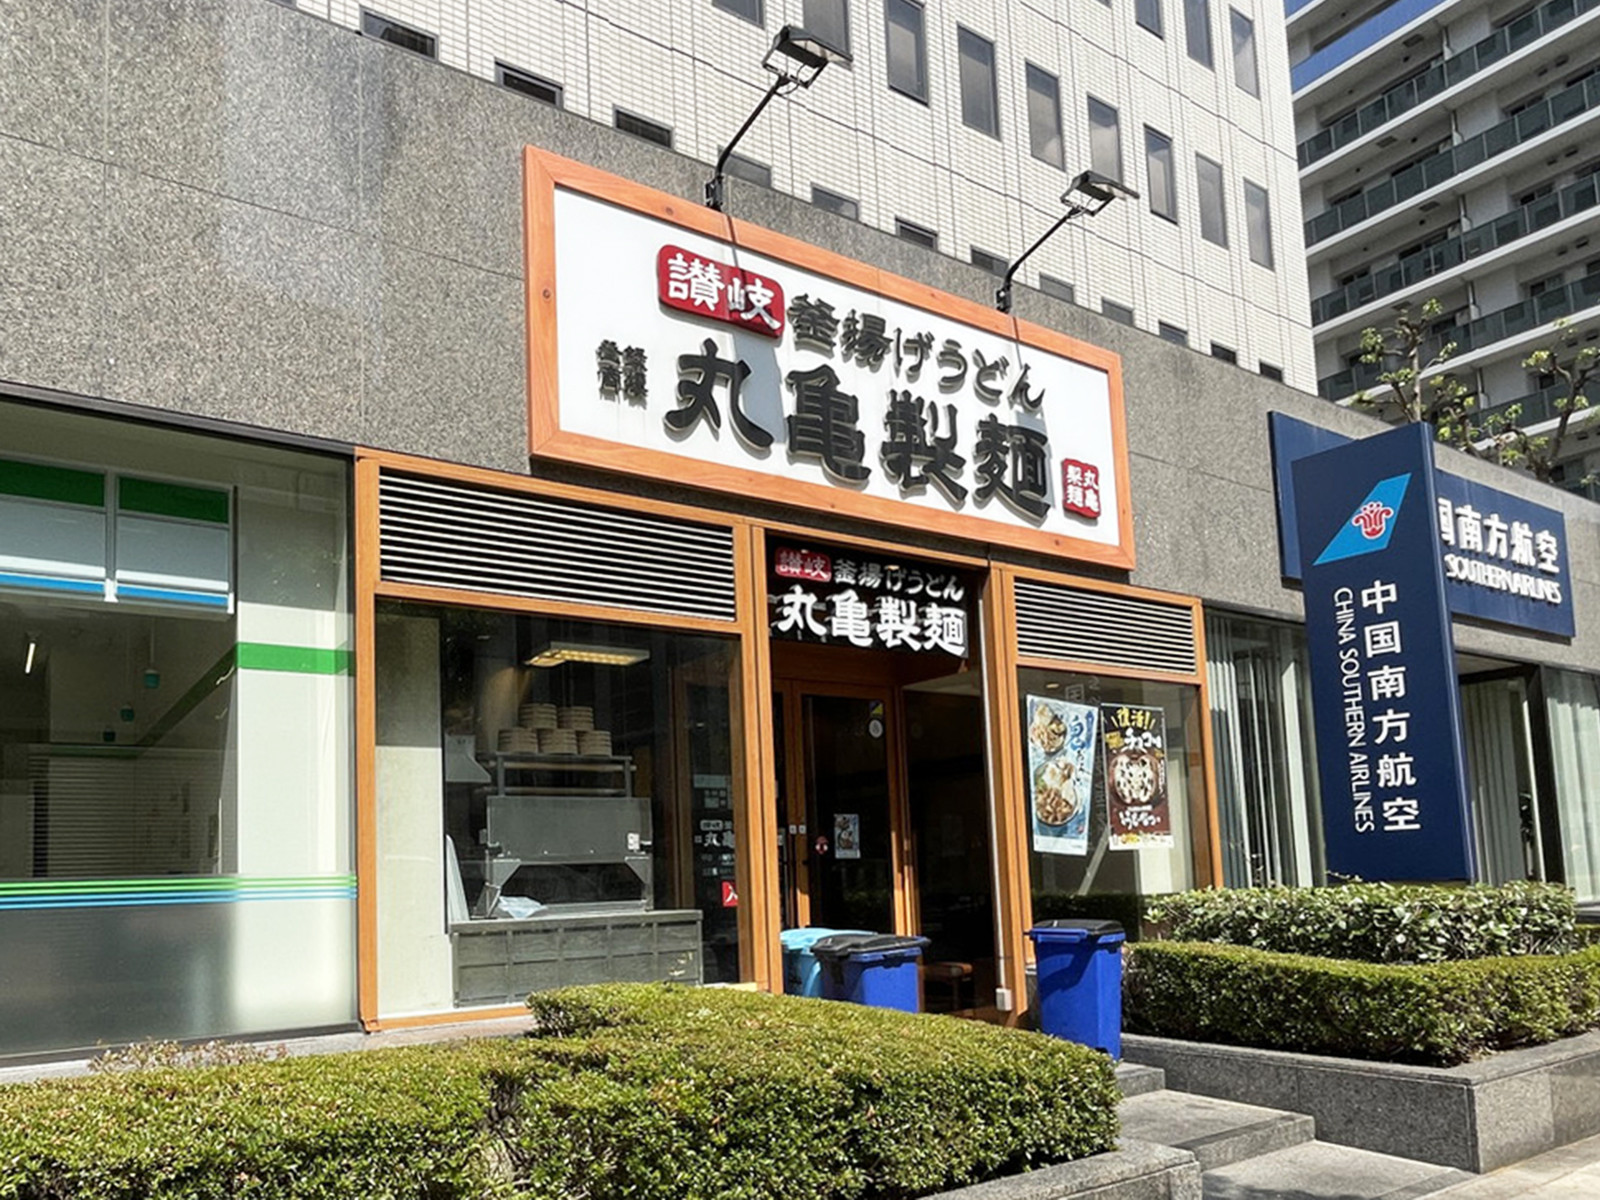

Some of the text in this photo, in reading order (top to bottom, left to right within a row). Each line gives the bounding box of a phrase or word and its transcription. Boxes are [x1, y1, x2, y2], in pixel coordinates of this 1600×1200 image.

[667, 253, 1046, 409] 讃岐 釜揚げうどん
[664, 337, 1050, 522] 丸亀製麺
[777, 584, 966, 657] 丸亀製麺
[778, 550, 965, 602] 讃岐 釜揚げうどん
[1333, 587, 1375, 833] CHINA SOUTHERN AIRLINES
[1361, 579, 1421, 832] 中国南方航空
